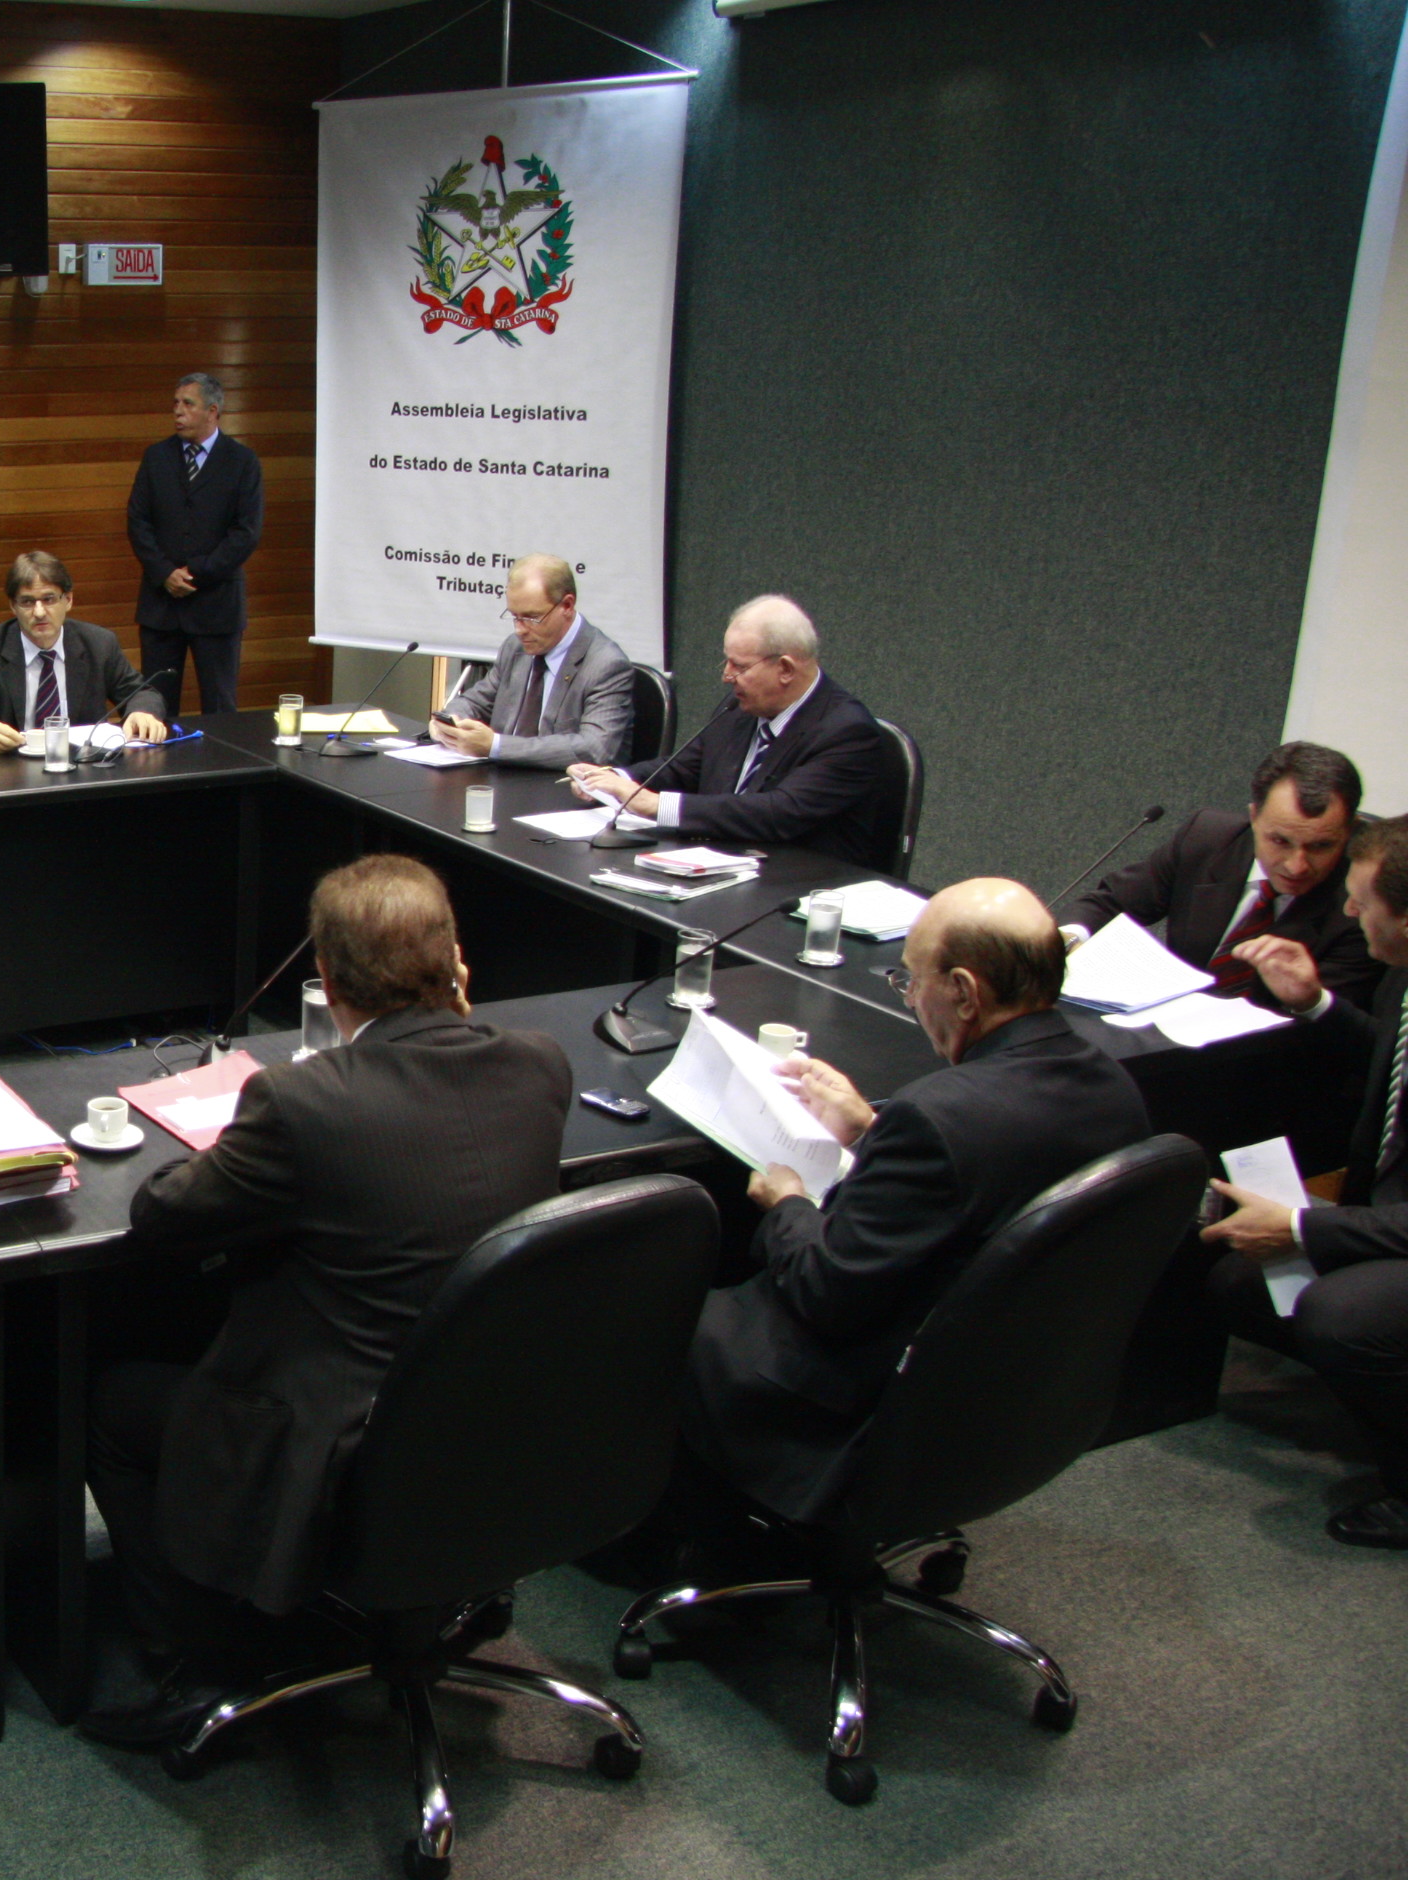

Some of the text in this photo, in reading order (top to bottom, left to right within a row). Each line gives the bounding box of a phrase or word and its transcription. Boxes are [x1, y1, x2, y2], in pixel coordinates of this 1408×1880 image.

[424, 309, 460, 323] ESTADO
[461, 316, 474, 328] DE
[514, 308, 556, 325] CATARINA
[391, 401, 588, 424] Assembleia Legislativa
[369, 454, 610, 479] do Estado de Santa Catarina
[384, 545, 461, 565] Comissão
[466, 552, 486, 567] de
[575, 562, 586, 574] e
[436, 575, 509, 599] Tributaç
